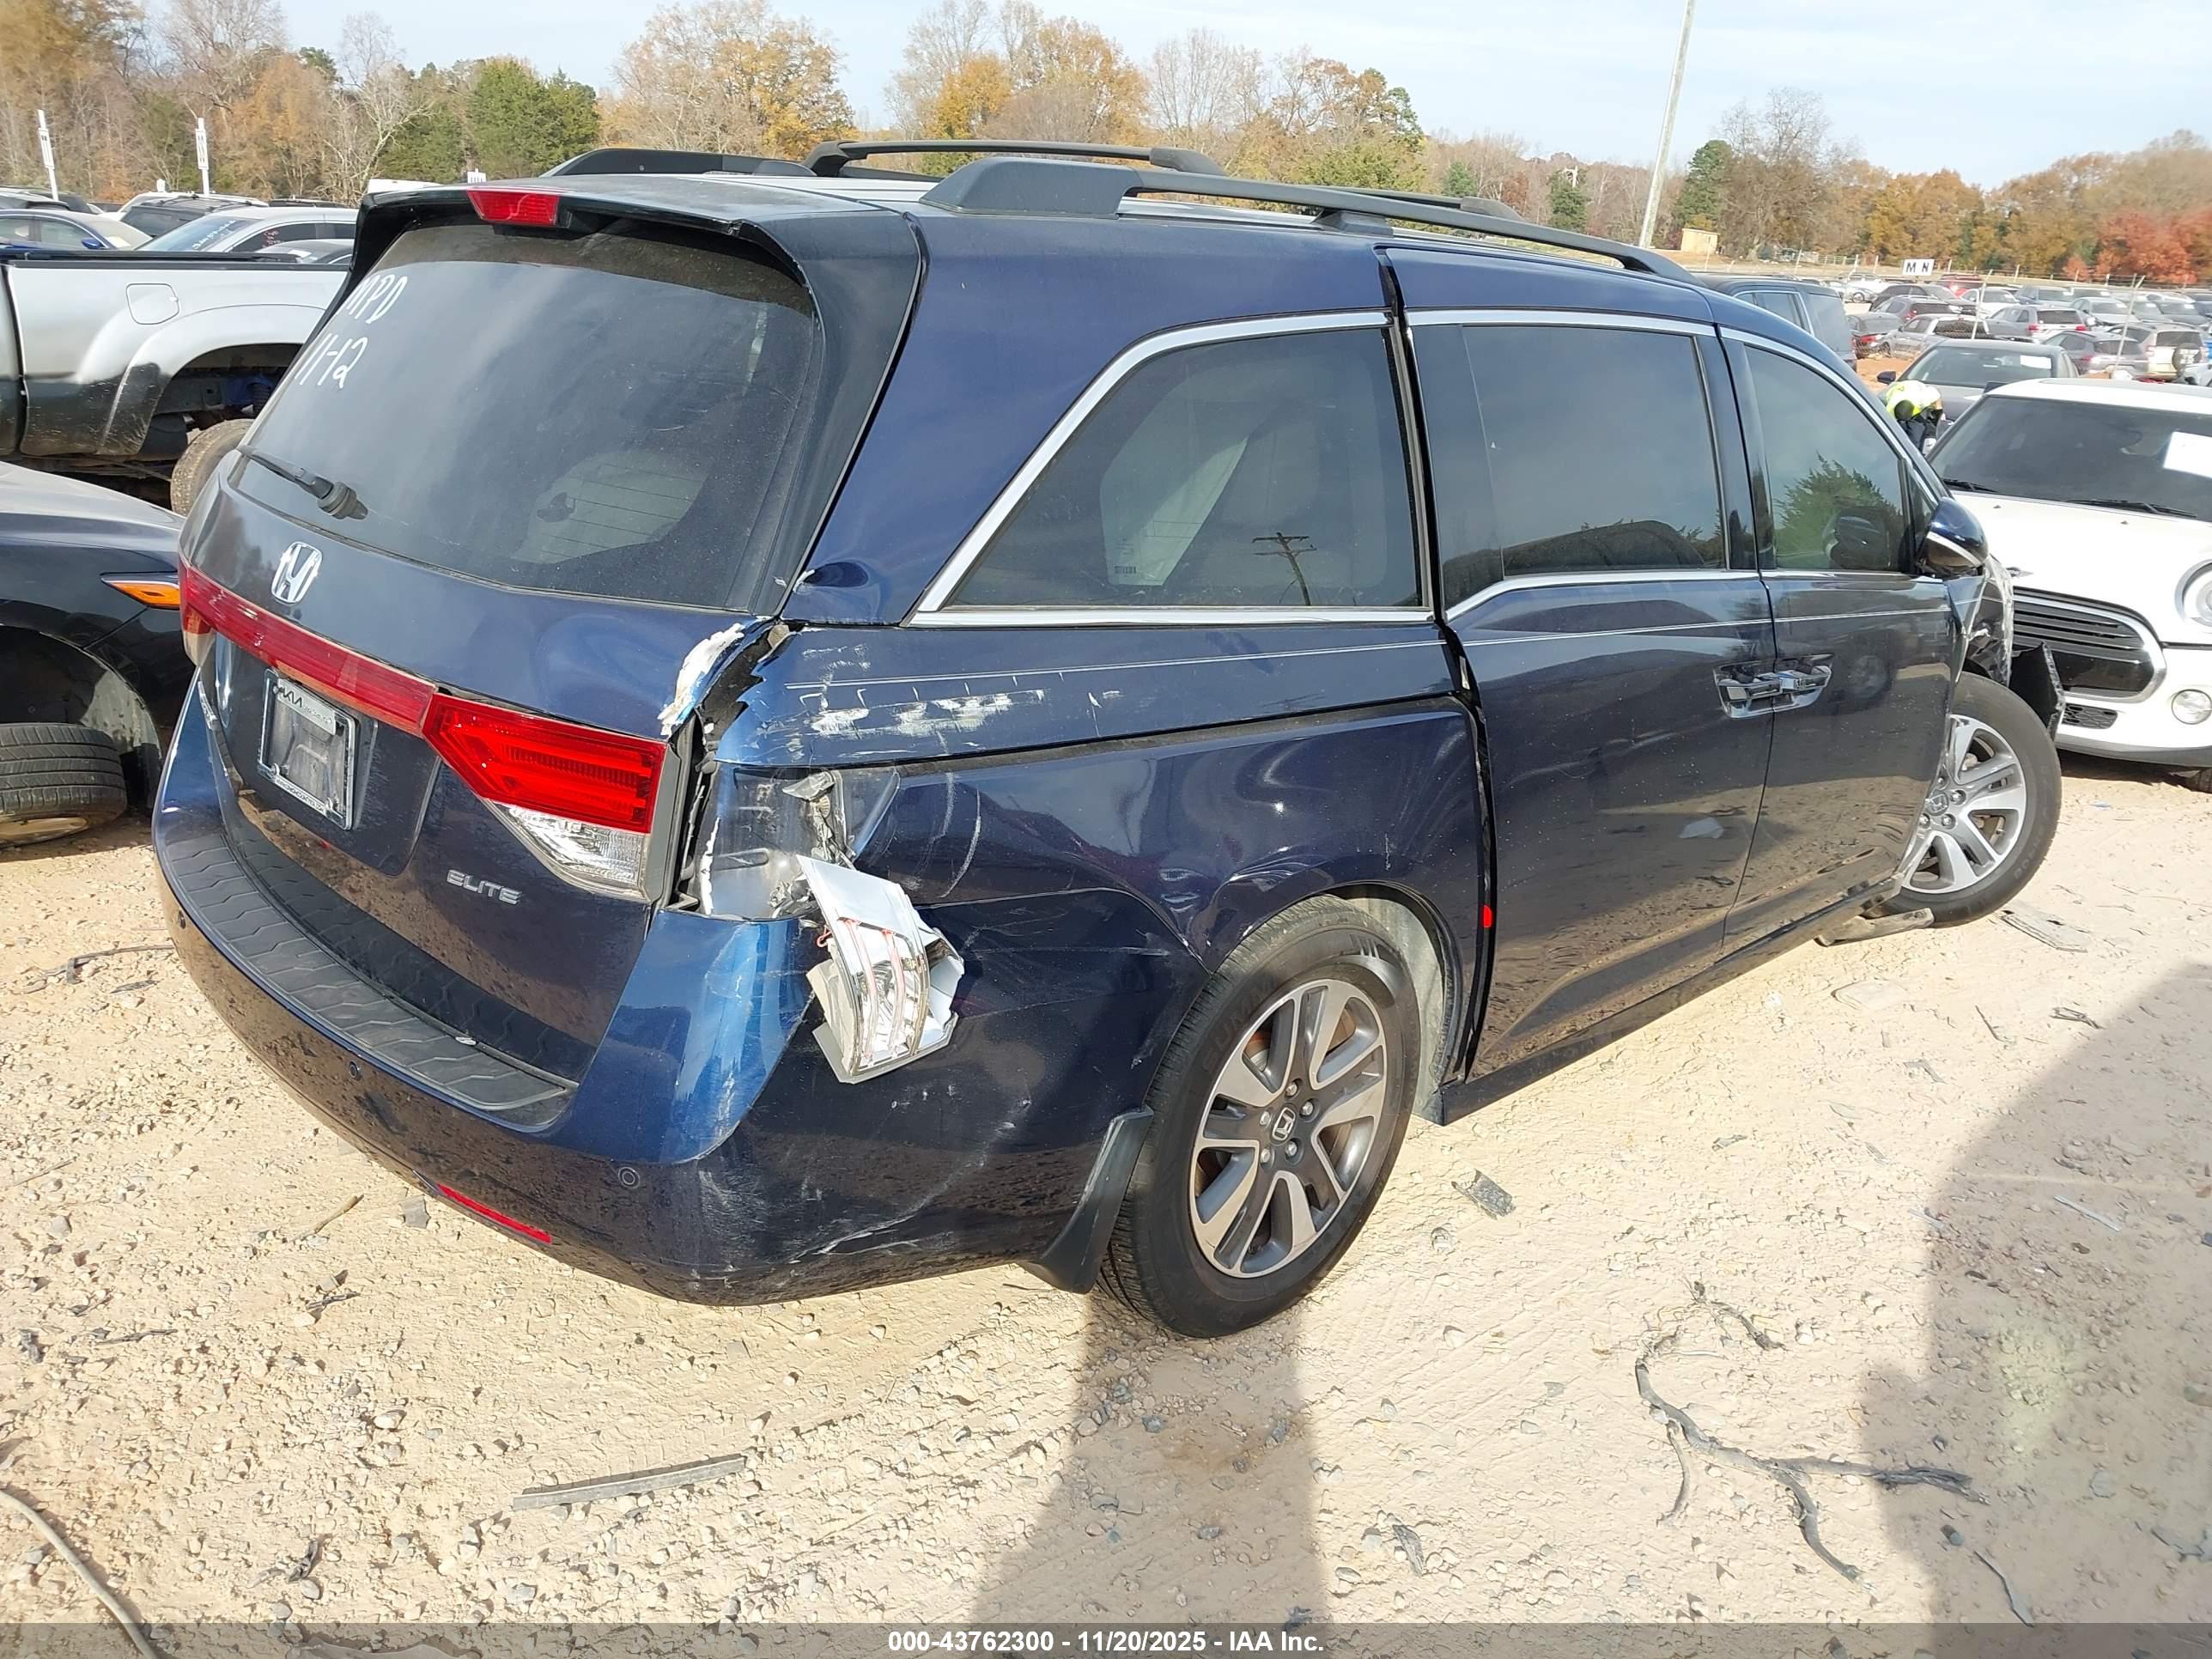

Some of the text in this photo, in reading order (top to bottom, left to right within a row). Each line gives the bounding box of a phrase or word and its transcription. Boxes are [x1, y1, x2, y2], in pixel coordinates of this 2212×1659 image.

[1905, 263, 1929, 273] M N
[447, 869, 522, 905] ELITE
